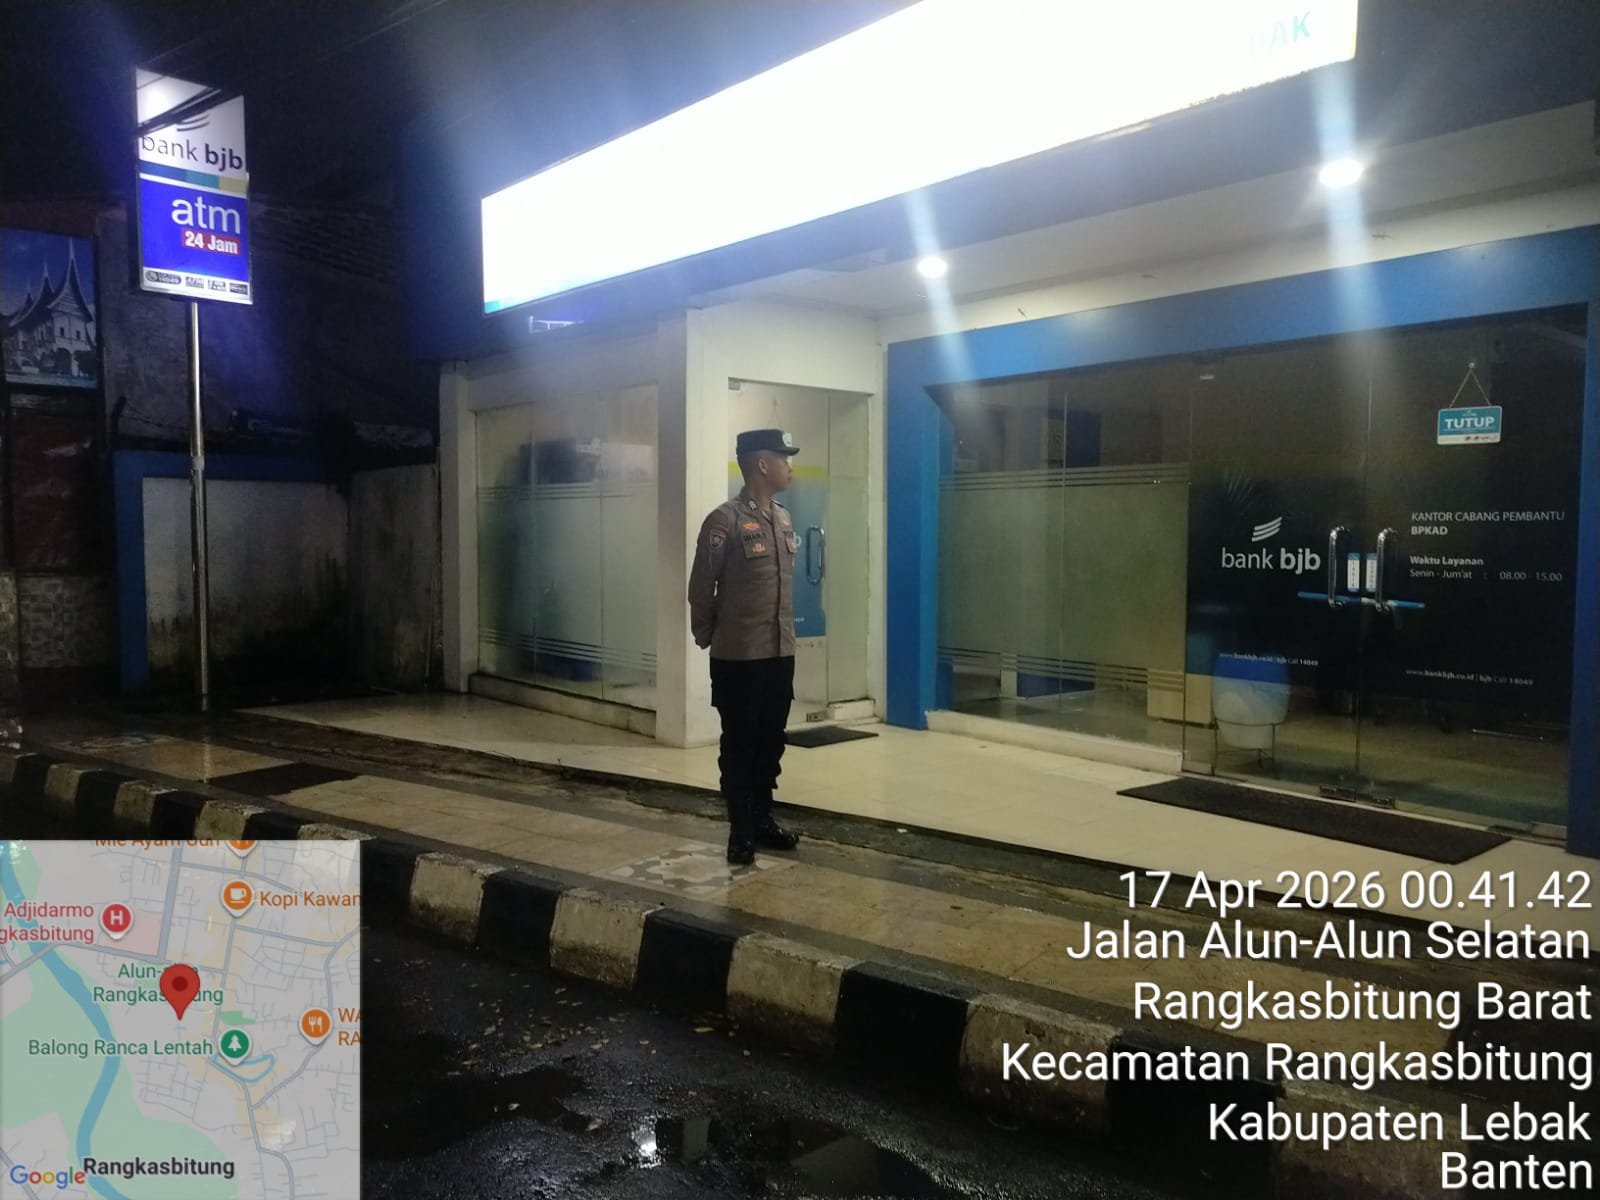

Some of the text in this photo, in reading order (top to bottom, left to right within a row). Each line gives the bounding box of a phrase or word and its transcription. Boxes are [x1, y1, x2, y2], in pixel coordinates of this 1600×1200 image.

[142, 136, 243, 172] bank bjb
[171, 196, 241, 234] atm
[184, 230, 239, 255] 24 Jam
[1444, 416, 1495, 431] TUTUP
[1411, 510, 1565, 522] KANTOR CABANG PEMBANTU
[1410, 526, 1448, 536] BPKAD
[1221, 546, 1321, 576] bank bjb
[1409, 555, 1484, 568] Waktu Layanan
[1409, 569, 1435, 579] Senin
[1441, 569, 1473, 580] Jum'at
[1499, 570, 1527, 582] 08.00
[1535, 571, 1563, 582] 15.00
